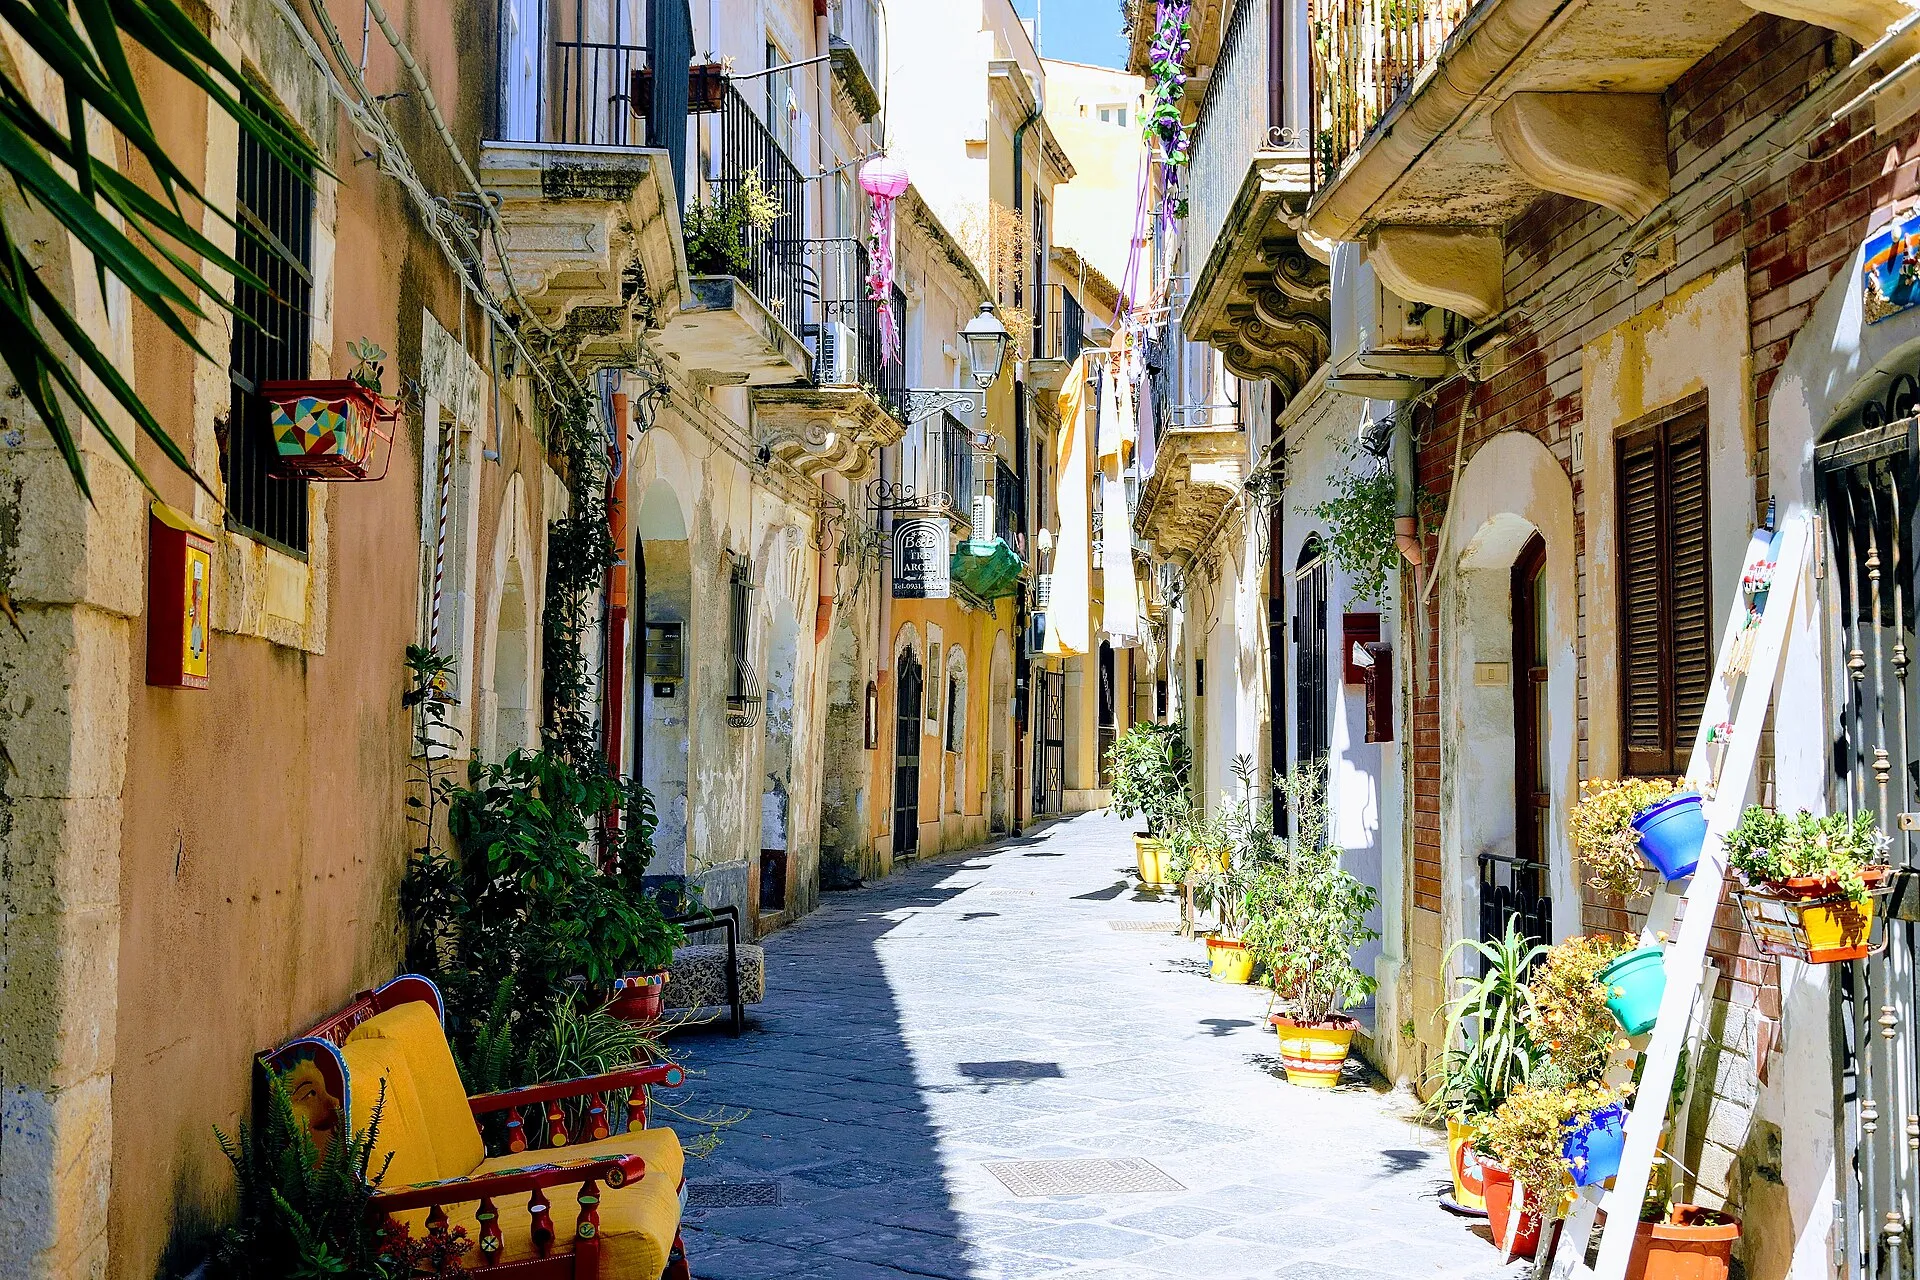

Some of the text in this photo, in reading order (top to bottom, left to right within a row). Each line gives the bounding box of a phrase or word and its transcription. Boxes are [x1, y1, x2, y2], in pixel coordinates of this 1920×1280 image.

[1574, 431, 1584, 462] 17
[904, 536, 936, 548] B&B
[910, 551, 931, 560] TRE
